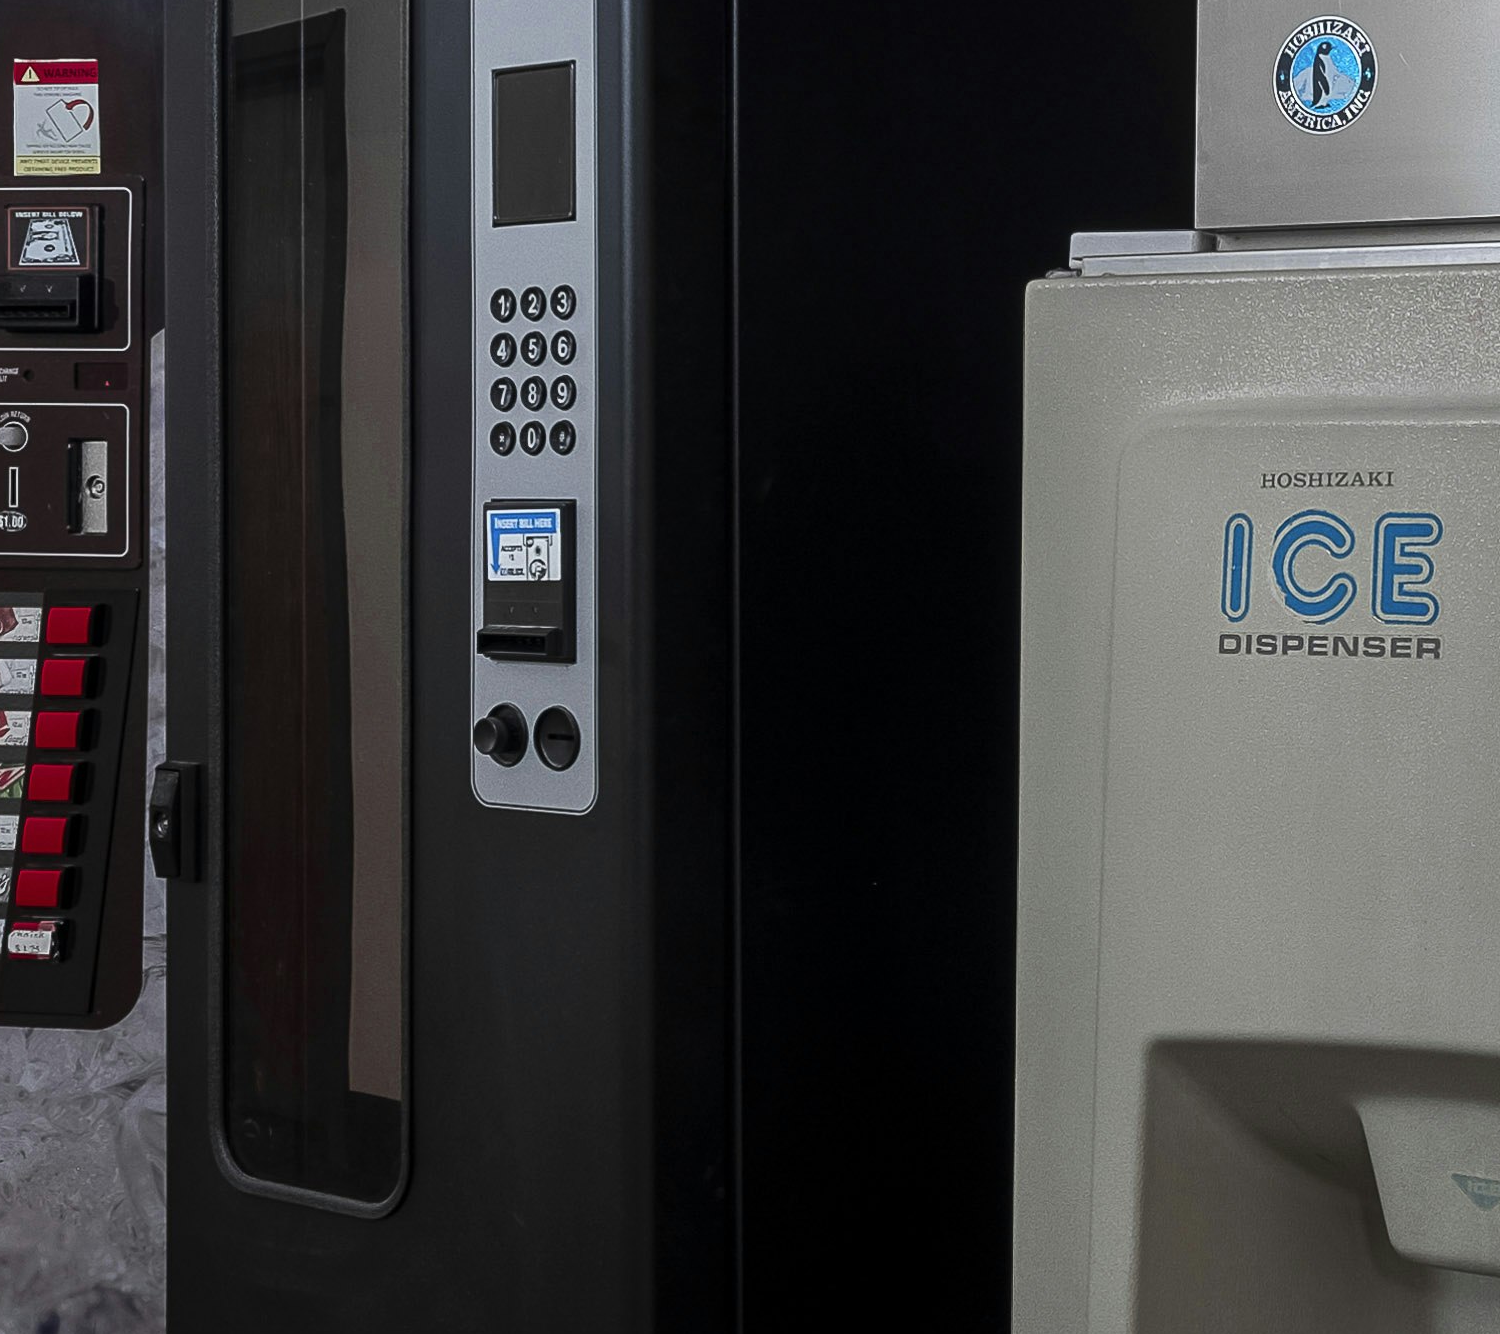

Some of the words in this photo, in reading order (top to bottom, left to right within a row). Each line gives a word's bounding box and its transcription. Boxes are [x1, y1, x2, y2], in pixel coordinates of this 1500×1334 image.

[1283, 21, 1370, 58] HOSHIZAKI
[44, 68, 97, 78] WARNING
[498, 295, 506, 315] 1
[528, 294, 537, 313] 2
[557, 292, 568, 313] 3
[497, 340, 506, 359] 4
[528, 339, 537, 358] 5
[557, 336, 568, 357] 6
[498, 385, 507, 405] 7
[528, 383, 537, 404] 8
[557, 382, 567, 403] 9
[527, 428, 536, 448] 0
[1260, 471, 1395, 489] HOSHIZAKI
[494, 517, 518, 529] INSERT
[519, 517, 533, 529] BILL
[534, 517, 553, 528] HERE
[1221, 509, 1444, 626] ICE
[1218, 633, 1442, 660] DISPENSER
